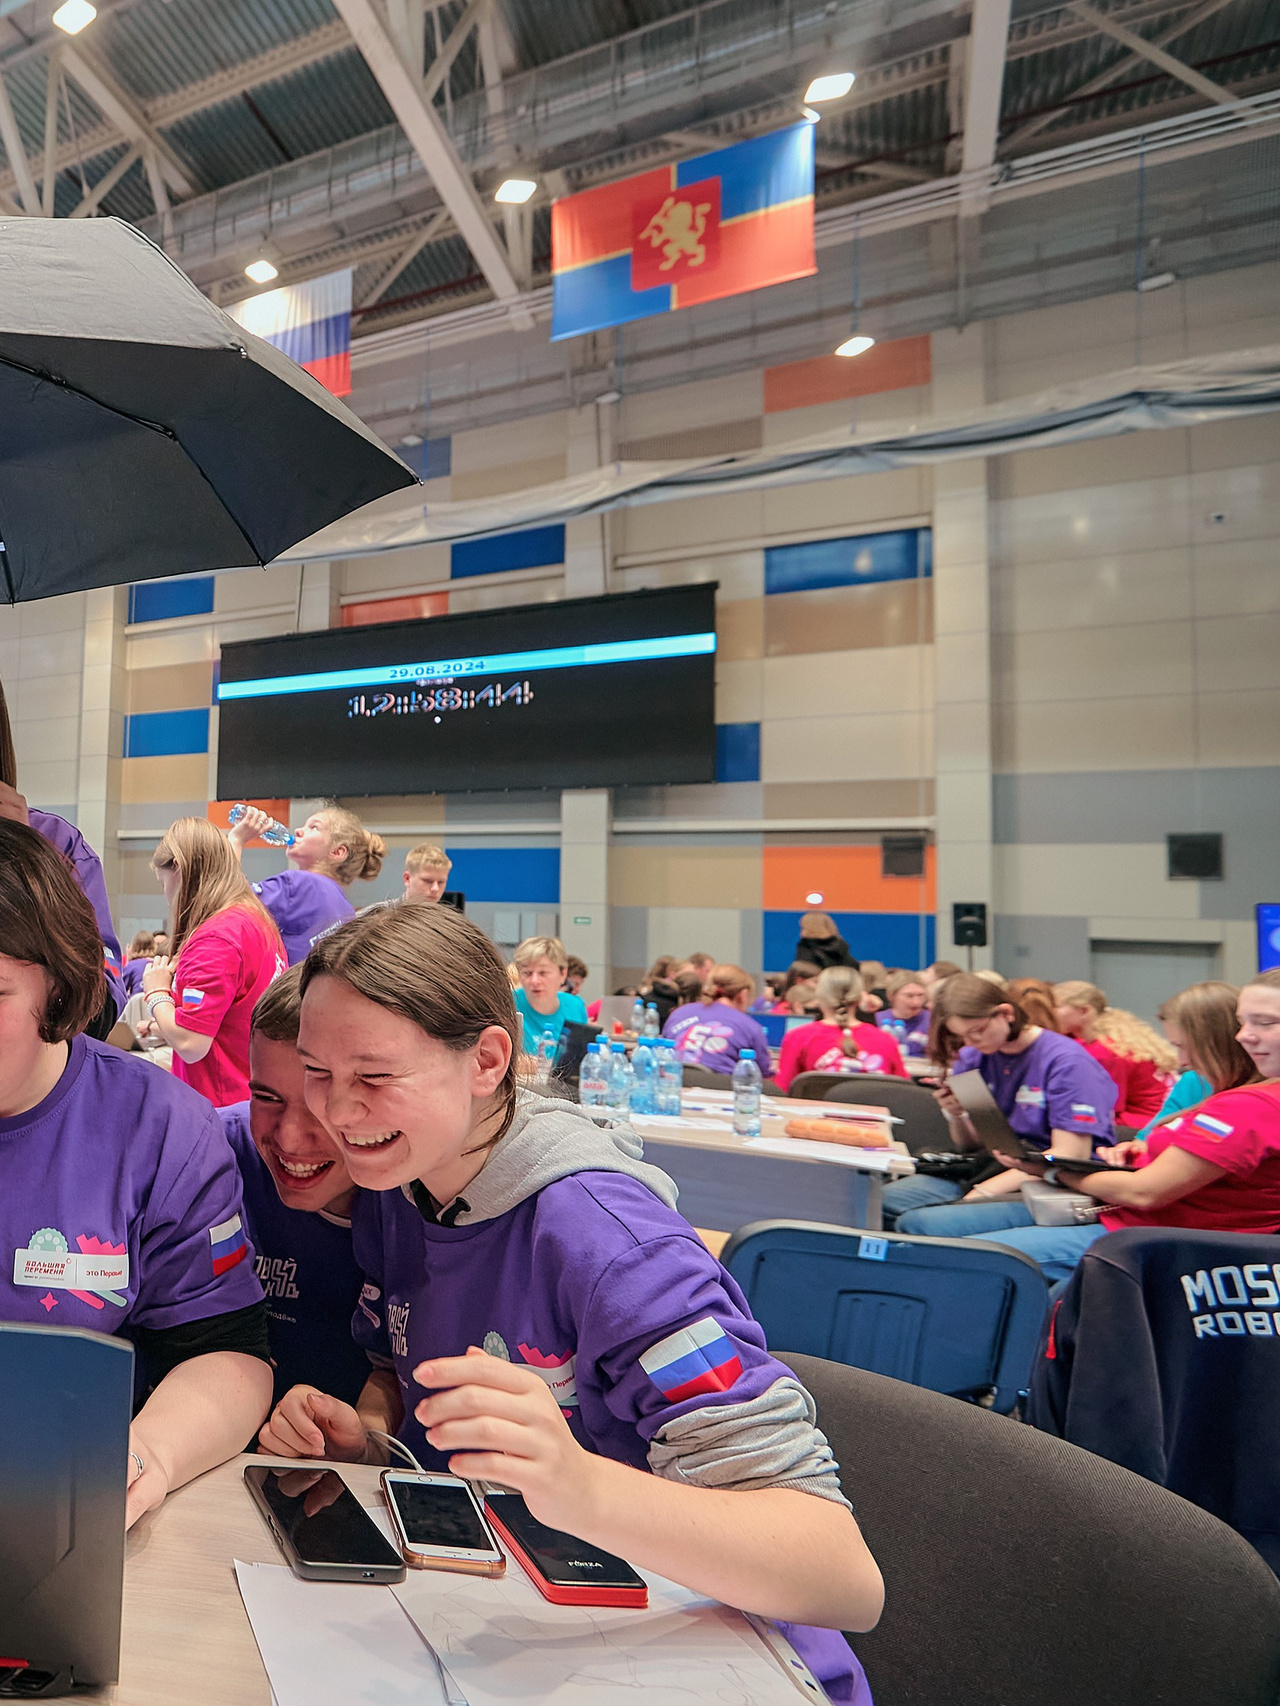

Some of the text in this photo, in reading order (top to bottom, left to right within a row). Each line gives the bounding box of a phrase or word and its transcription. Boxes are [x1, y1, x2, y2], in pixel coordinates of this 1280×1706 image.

[389, 660, 486, 679] 29.08.2024
[865, 1243, 880, 1254] 11
[26, 1260, 66, 1269] БОЛЬШАЯ
[24, 1267, 64, 1276] ПЕРЕМЕНА
[1192, 1311, 1280, 1339] ROB
